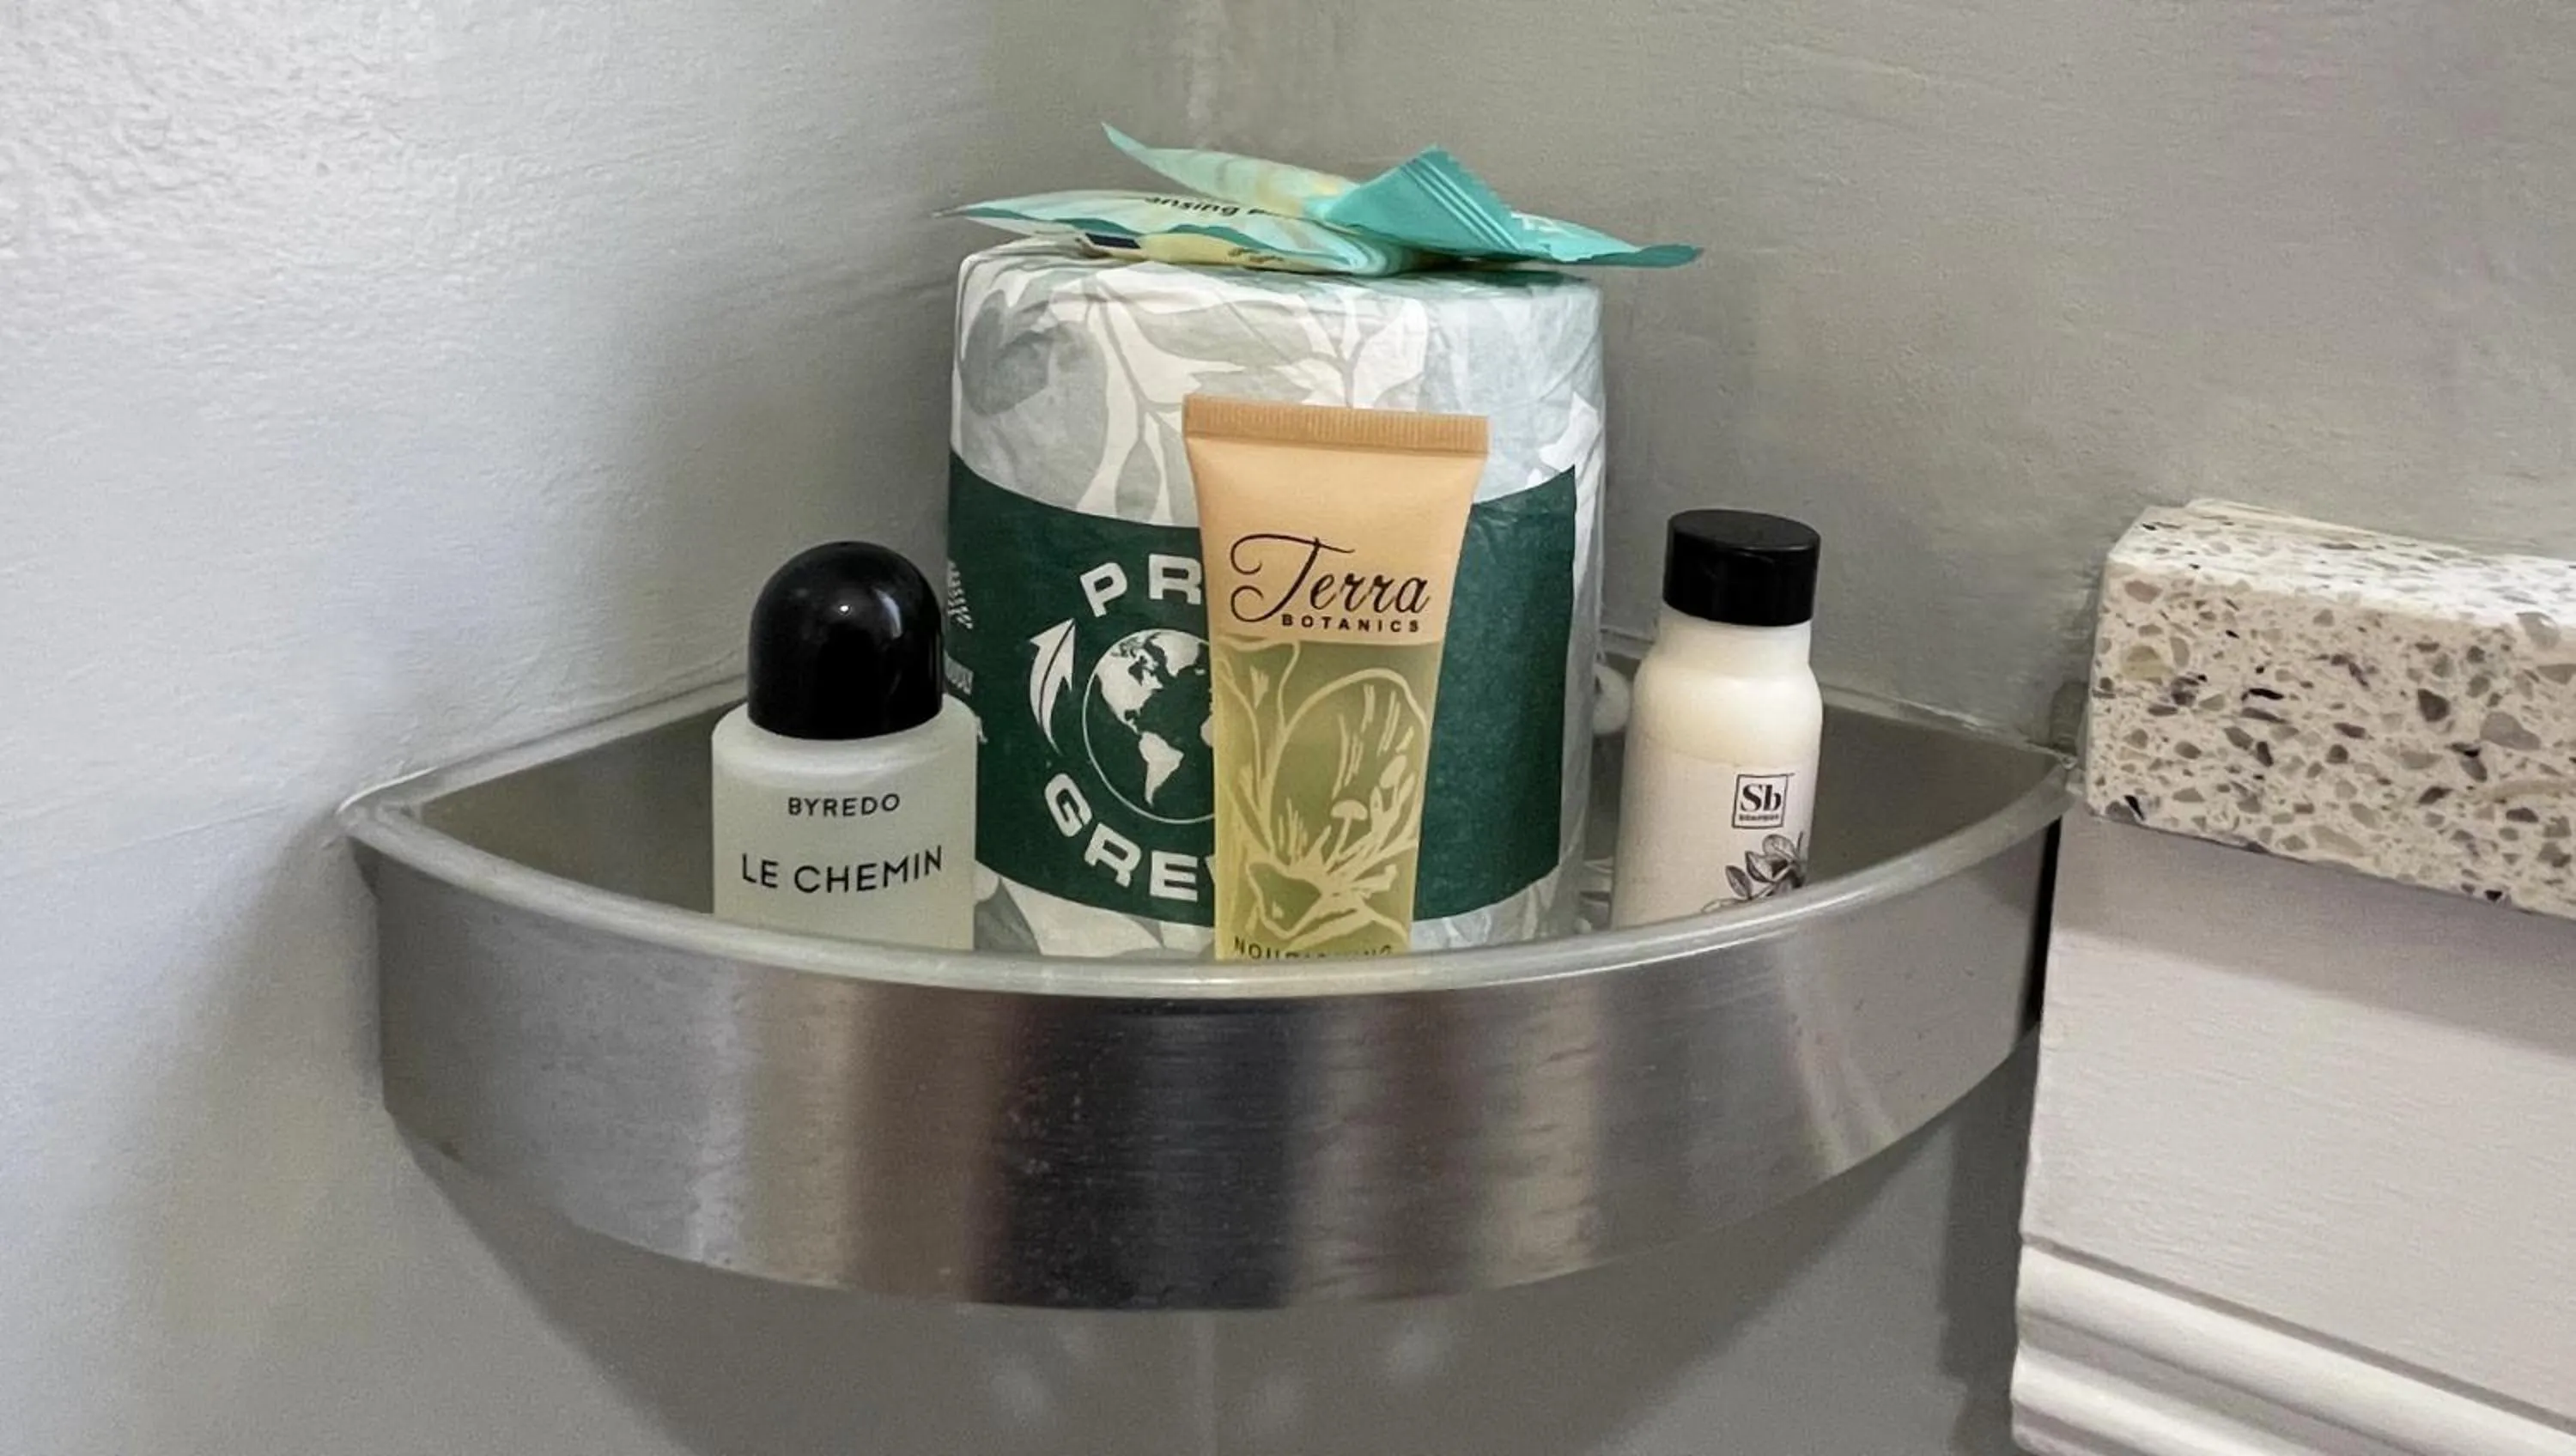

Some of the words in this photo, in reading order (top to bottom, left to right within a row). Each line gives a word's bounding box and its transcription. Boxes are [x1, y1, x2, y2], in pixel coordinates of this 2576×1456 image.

[1230, 533, 1431, 623] Terra
[1281, 613, 1419, 633] BOTANICS
[787, 793, 901, 817] BYREDO
[1740, 783, 1782, 811] Sb
[1044, 773, 1215, 902] GRE
[741, 852, 780, 889] LE
[793, 844, 943, 894] CHEMIN
